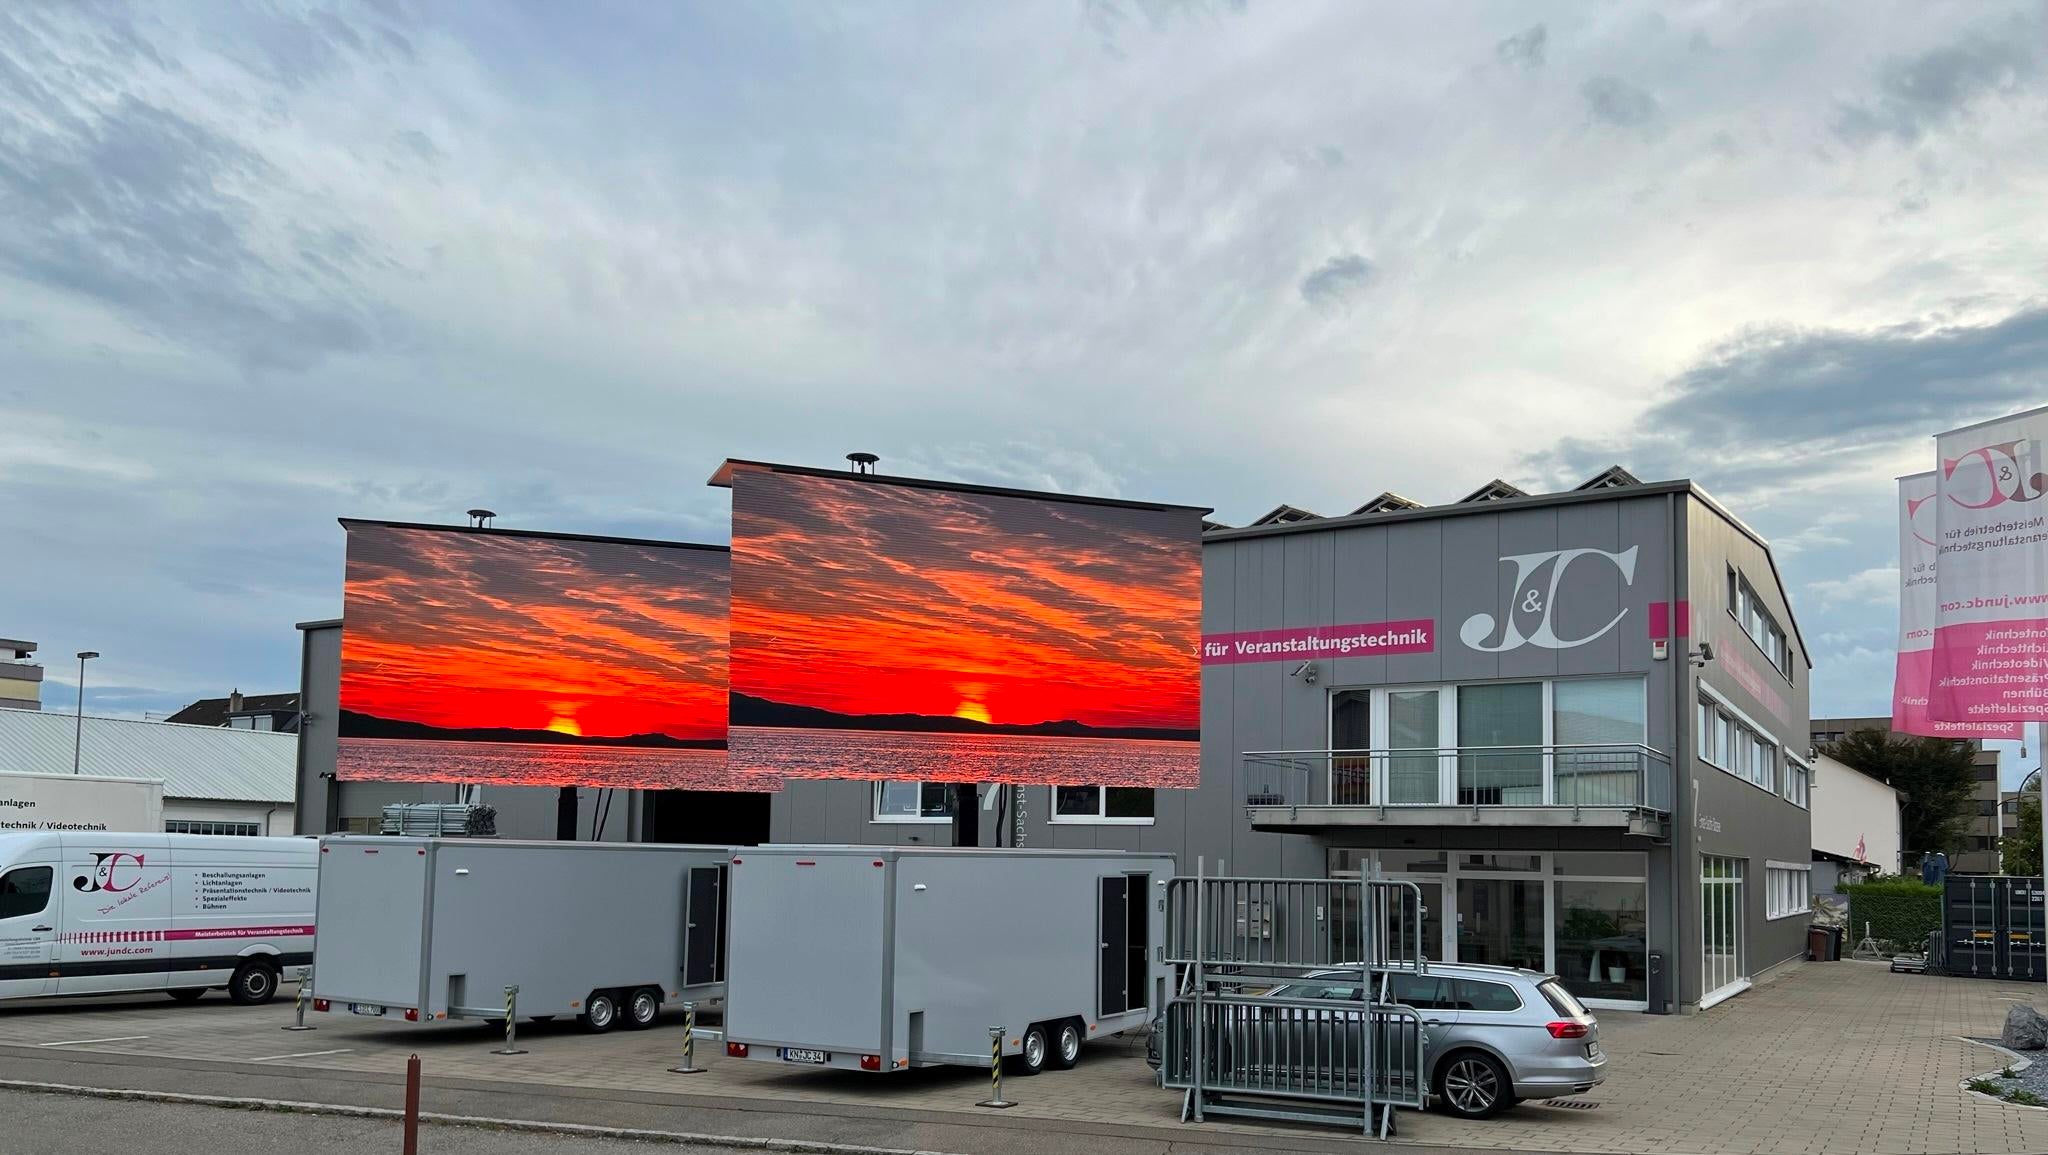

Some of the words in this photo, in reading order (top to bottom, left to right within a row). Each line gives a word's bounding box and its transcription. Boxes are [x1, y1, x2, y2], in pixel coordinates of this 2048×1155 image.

[1204, 642, 1229, 657] für
[1235, 630, 1428, 657] Veranstaltungstechnik
[1, 821, 37, 830] technik
[46, 822, 107, 831] Videotechnik
[73, 852, 145, 892] J&C
[202, 872, 266, 880] Beschallungsanlagen
[247, 928, 304, 936] Veranstaltungstechnik
[81, 947, 153, 957] www.jundc.com
